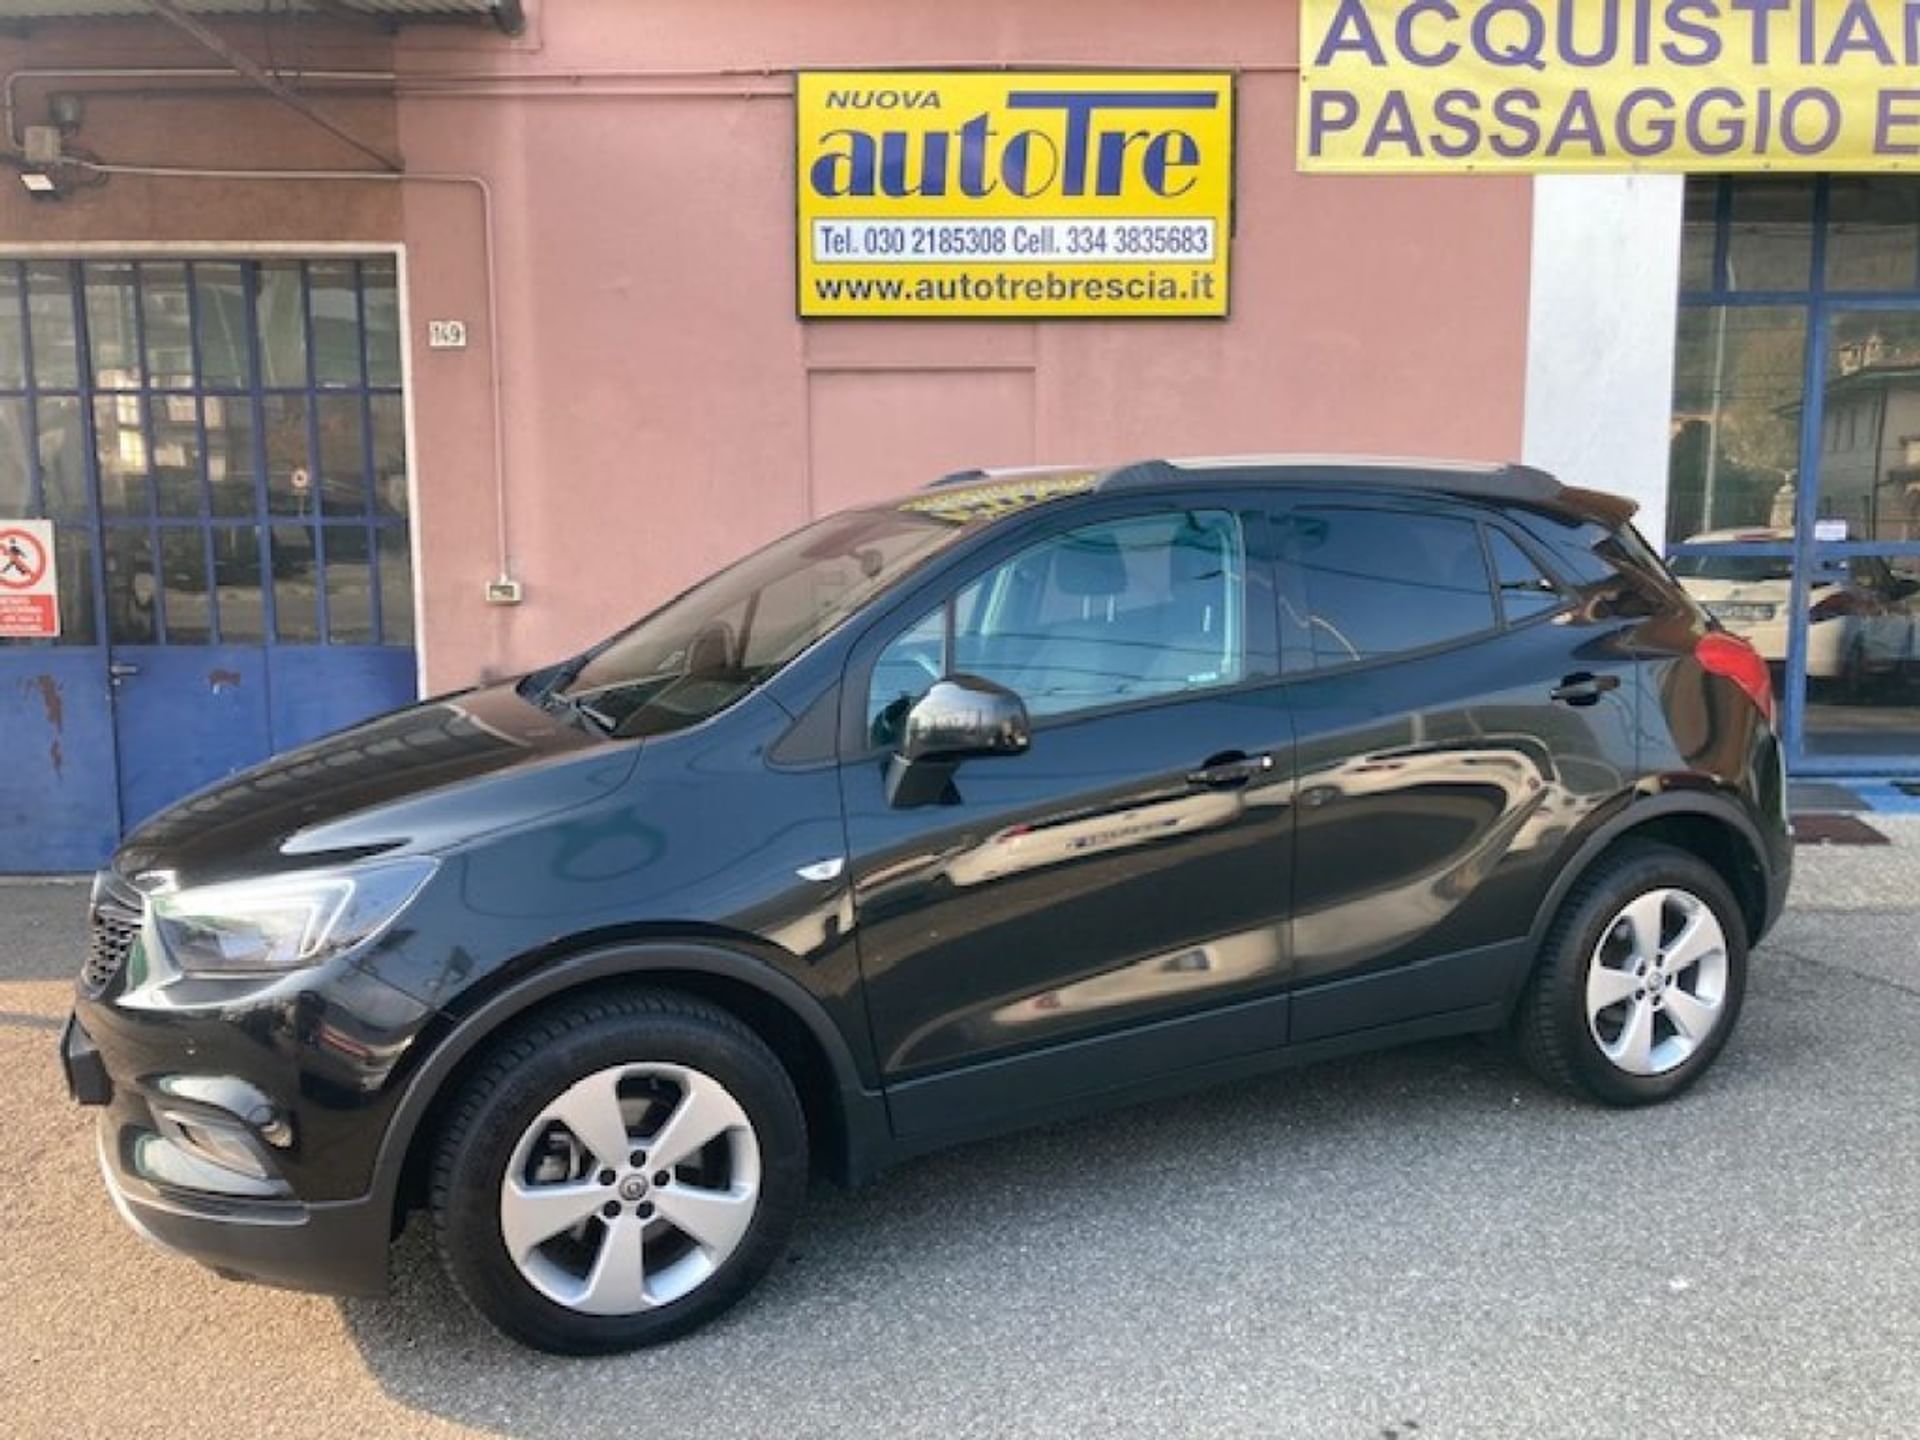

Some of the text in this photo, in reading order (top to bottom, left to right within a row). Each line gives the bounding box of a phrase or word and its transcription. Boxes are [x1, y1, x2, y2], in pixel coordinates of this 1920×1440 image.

[1313, 0, 1920, 70] ACQUISTIA
[825, 90, 942, 109] NUOVA
[1308, 87, 1842, 157] PASSAGGIO
[810, 91, 1219, 198] autoTre
[820, 225, 1208, 254] Tel. 030 2185308 Cell. 334 3835683
[815, 271, 1215, 300] www.autotrebrescia.it
[433, 324, 461, 344] 149
